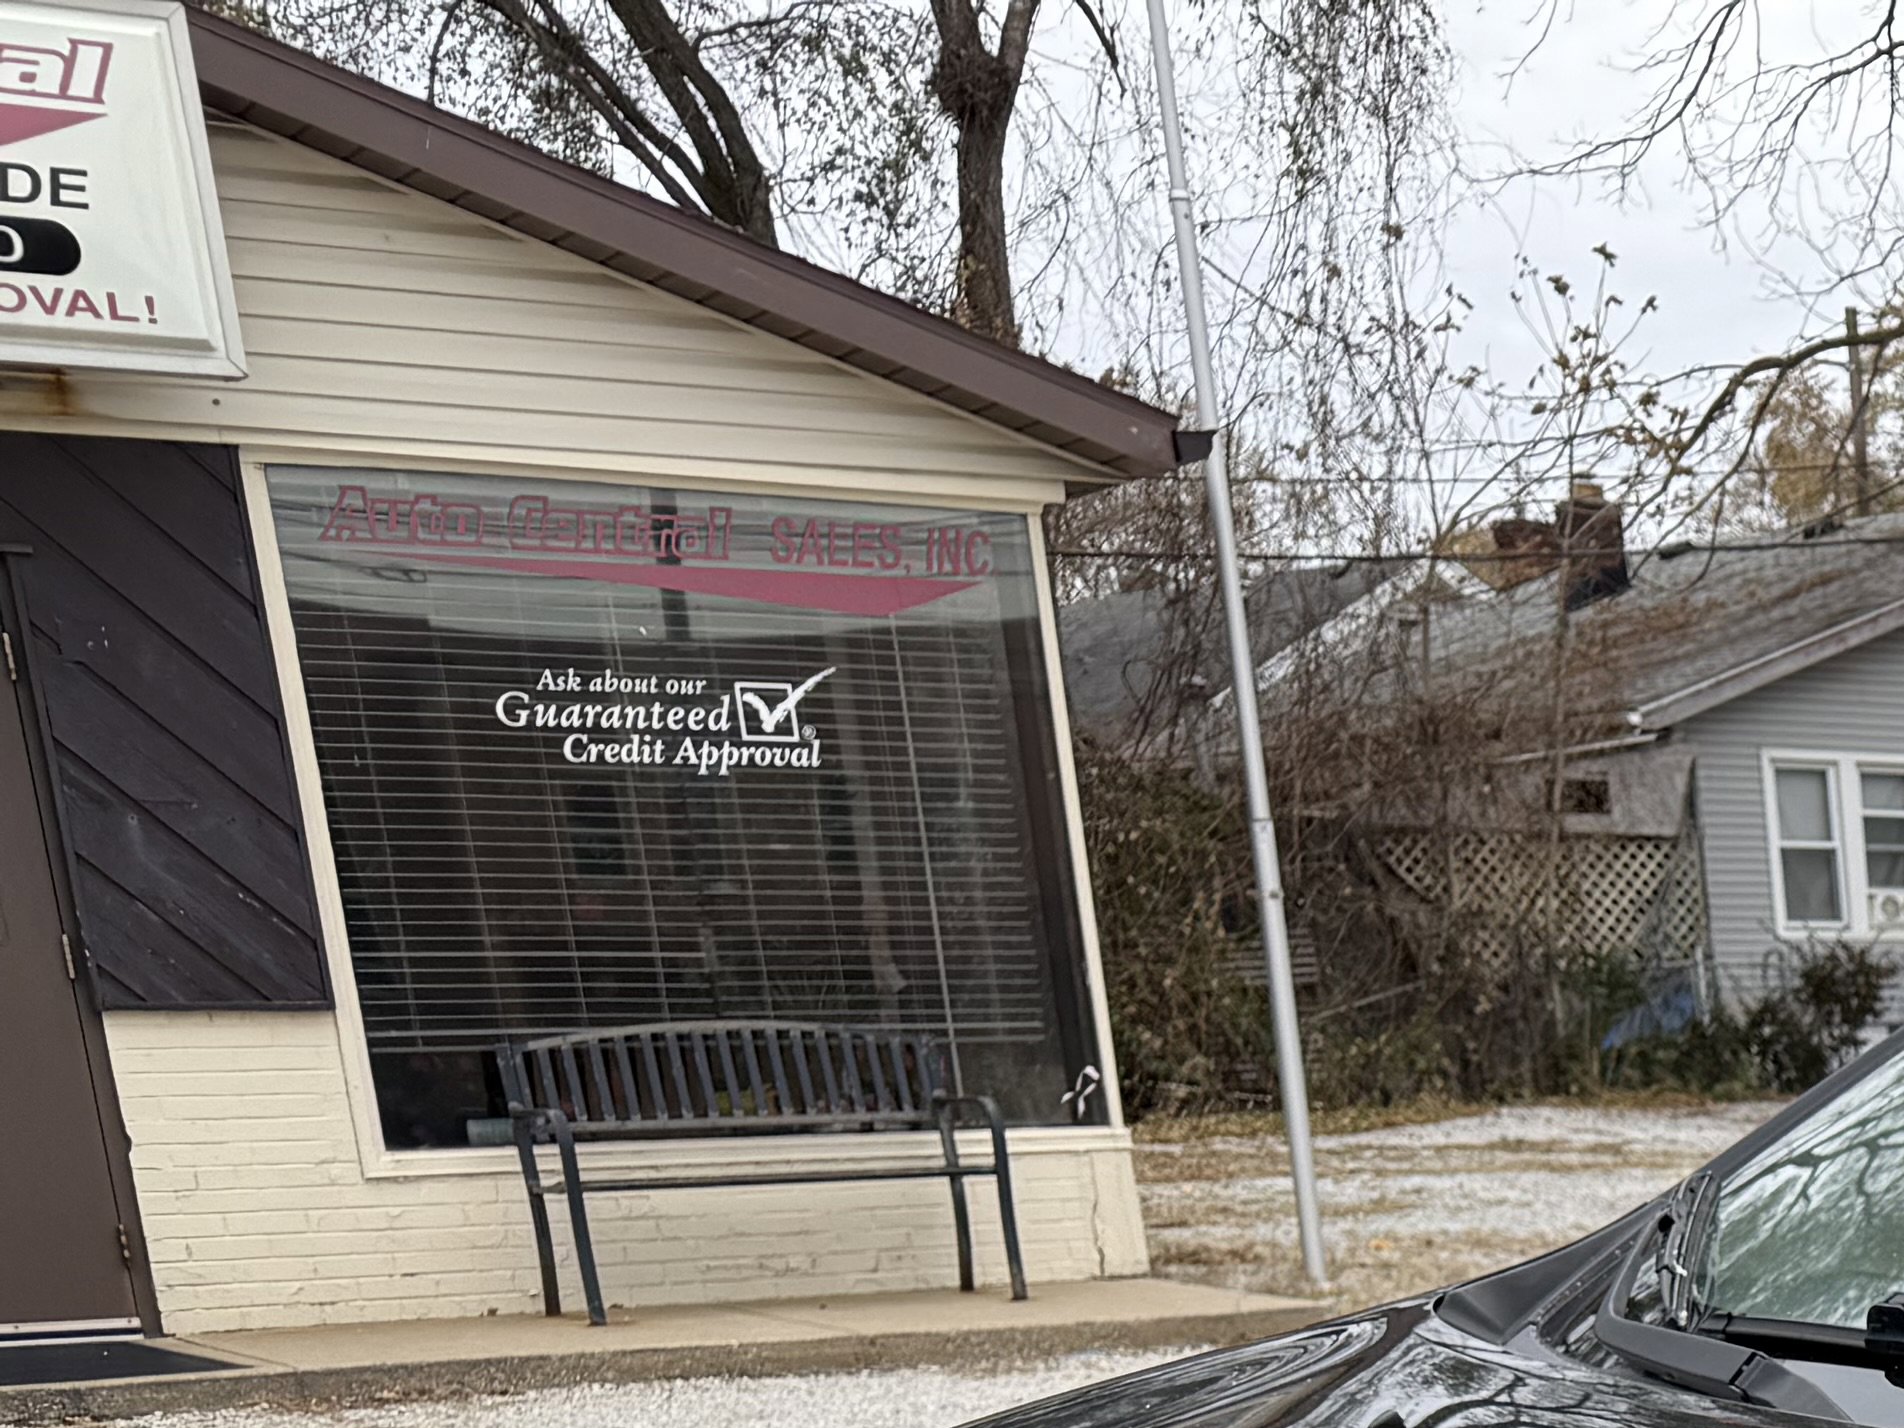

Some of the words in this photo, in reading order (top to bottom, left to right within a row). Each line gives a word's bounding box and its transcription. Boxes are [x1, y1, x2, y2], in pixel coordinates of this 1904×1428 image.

[0, 161, 89, 209] DE
[318, 486, 484, 546] Auto
[507, 495, 733, 561] Central
[769, 515, 911, 575] SALES,
[926, 529, 992, 577] INC
[536, 668, 582, 693] Ask
[589, 669, 659, 694] about
[665, 678, 707, 695] our
[495, 690, 732, 732] Guaranteed
[562, 732, 665, 765] Credit
[672, 736, 822, 776] Approval
